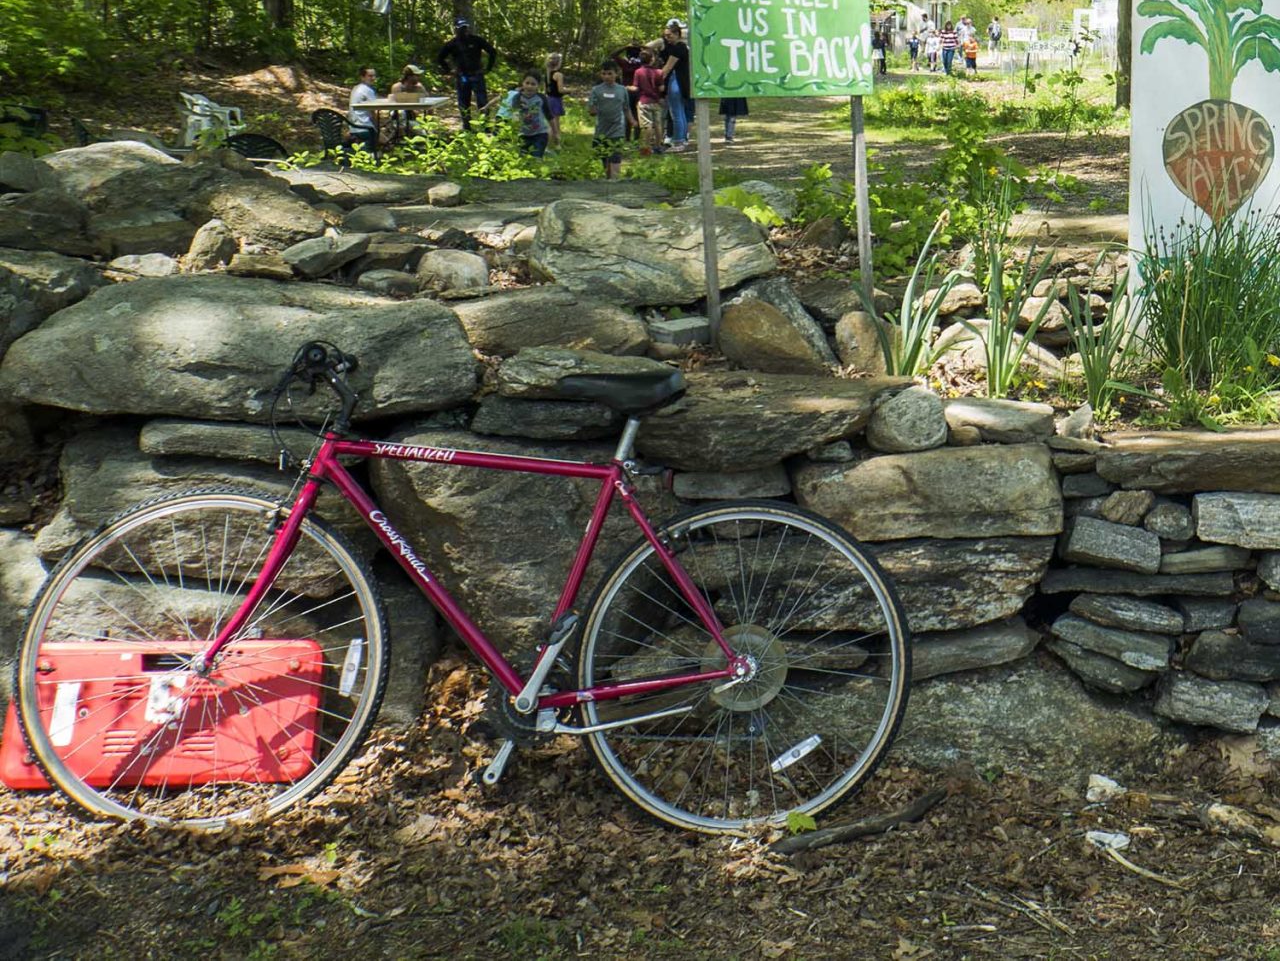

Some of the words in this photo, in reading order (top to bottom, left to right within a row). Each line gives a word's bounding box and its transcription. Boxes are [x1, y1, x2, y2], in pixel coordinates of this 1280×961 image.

[738, 7, 769, 37] US
[781, 8, 818, 39] IN
[720, 38, 779, 74] THE
[790, 23, 872, 82] BACK!
[1165, 102, 1272, 164] SPRING
[372, 443, 456, 462] SPECIALIZED
